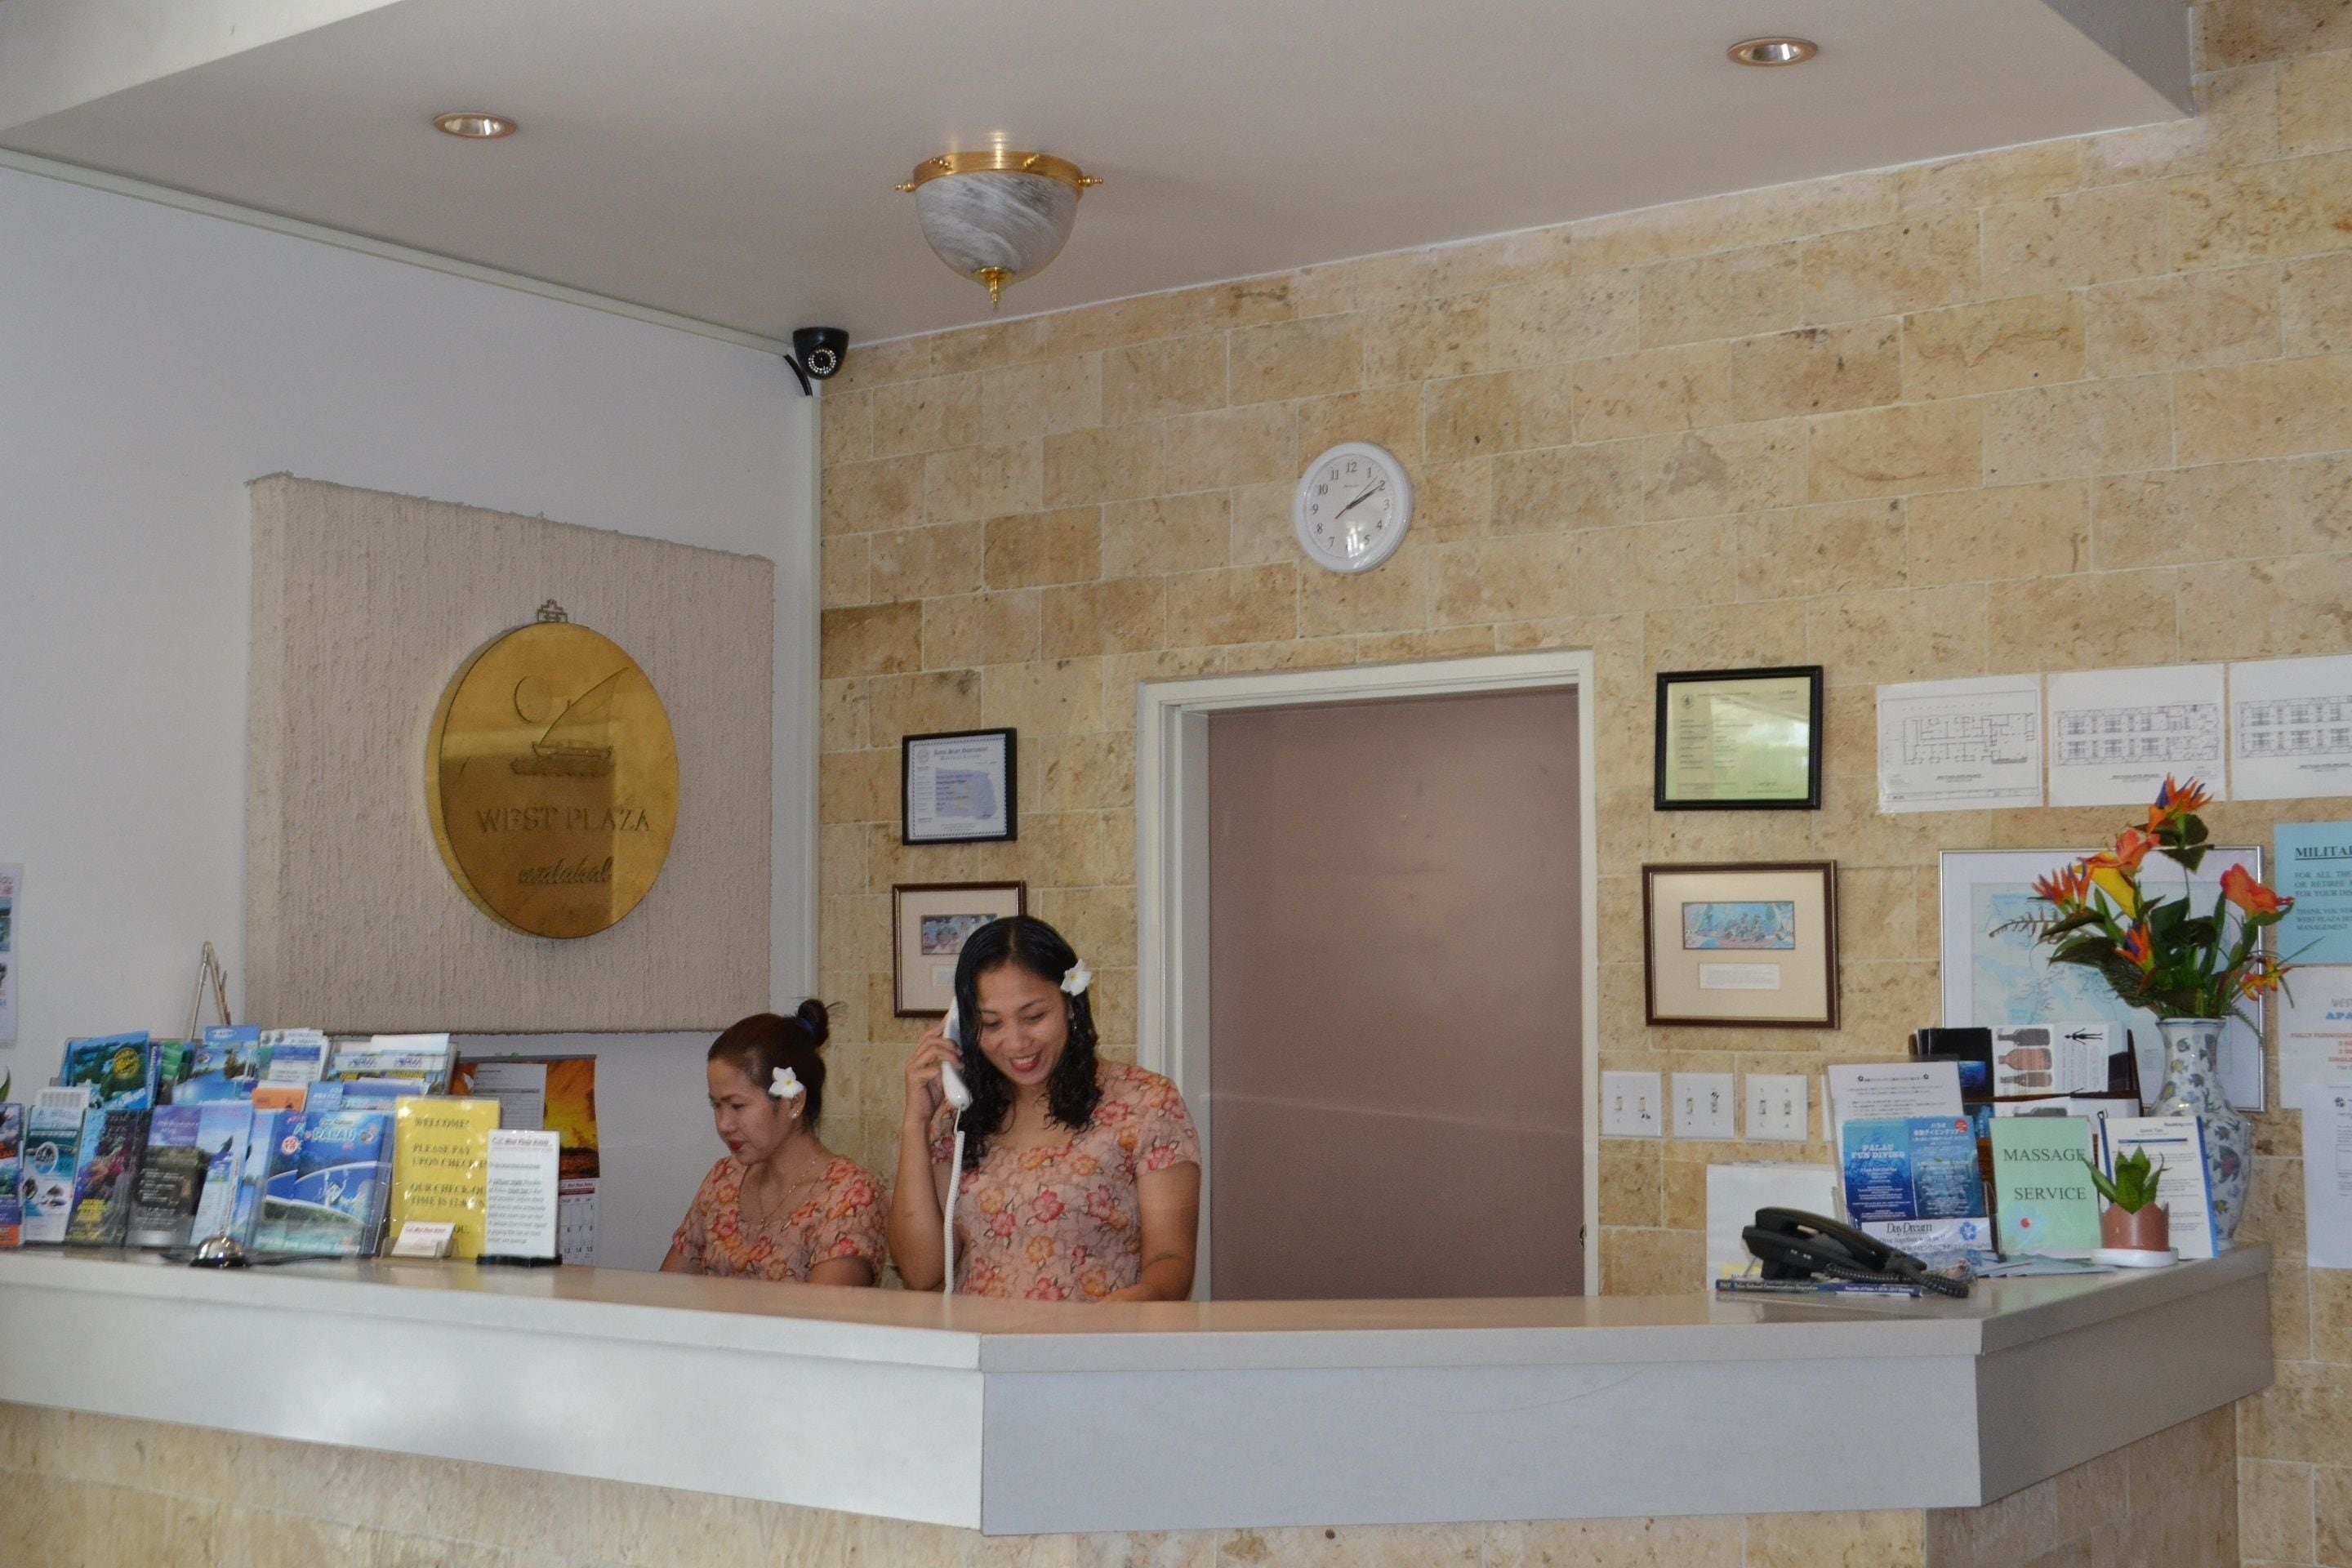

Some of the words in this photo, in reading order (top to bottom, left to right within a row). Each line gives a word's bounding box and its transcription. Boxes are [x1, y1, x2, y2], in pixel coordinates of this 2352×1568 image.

[1346, 461, 1357, 473] 12
[1366, 467, 1372, 478] 1
[1330, 470, 1339, 480] 11
[1317, 484, 1329, 495] 10
[1379, 480, 1386, 491] 2
[1312, 504, 1319, 514] 9
[1383, 500, 1390, 510] 3
[1316, 523, 1323, 533] 8
[1376, 520, 1383, 530] 4
[1329, 537, 1335, 549] 7
[1364, 535, 1370, 546] 5
[476, 808, 558, 833] WEST
[566, 807, 651, 831] PLAZA
[412, 1143, 449, 1154] PLEASE
[1862, 1143, 1895, 1152] PALAU
[1851, 1151, 1871, 1159] FUN
[1872, 1150, 1906, 1158] DIVING
[2003, 1148, 2085, 1161] MASSAGE
[2014, 1187, 2087, 1200] SERVICE
